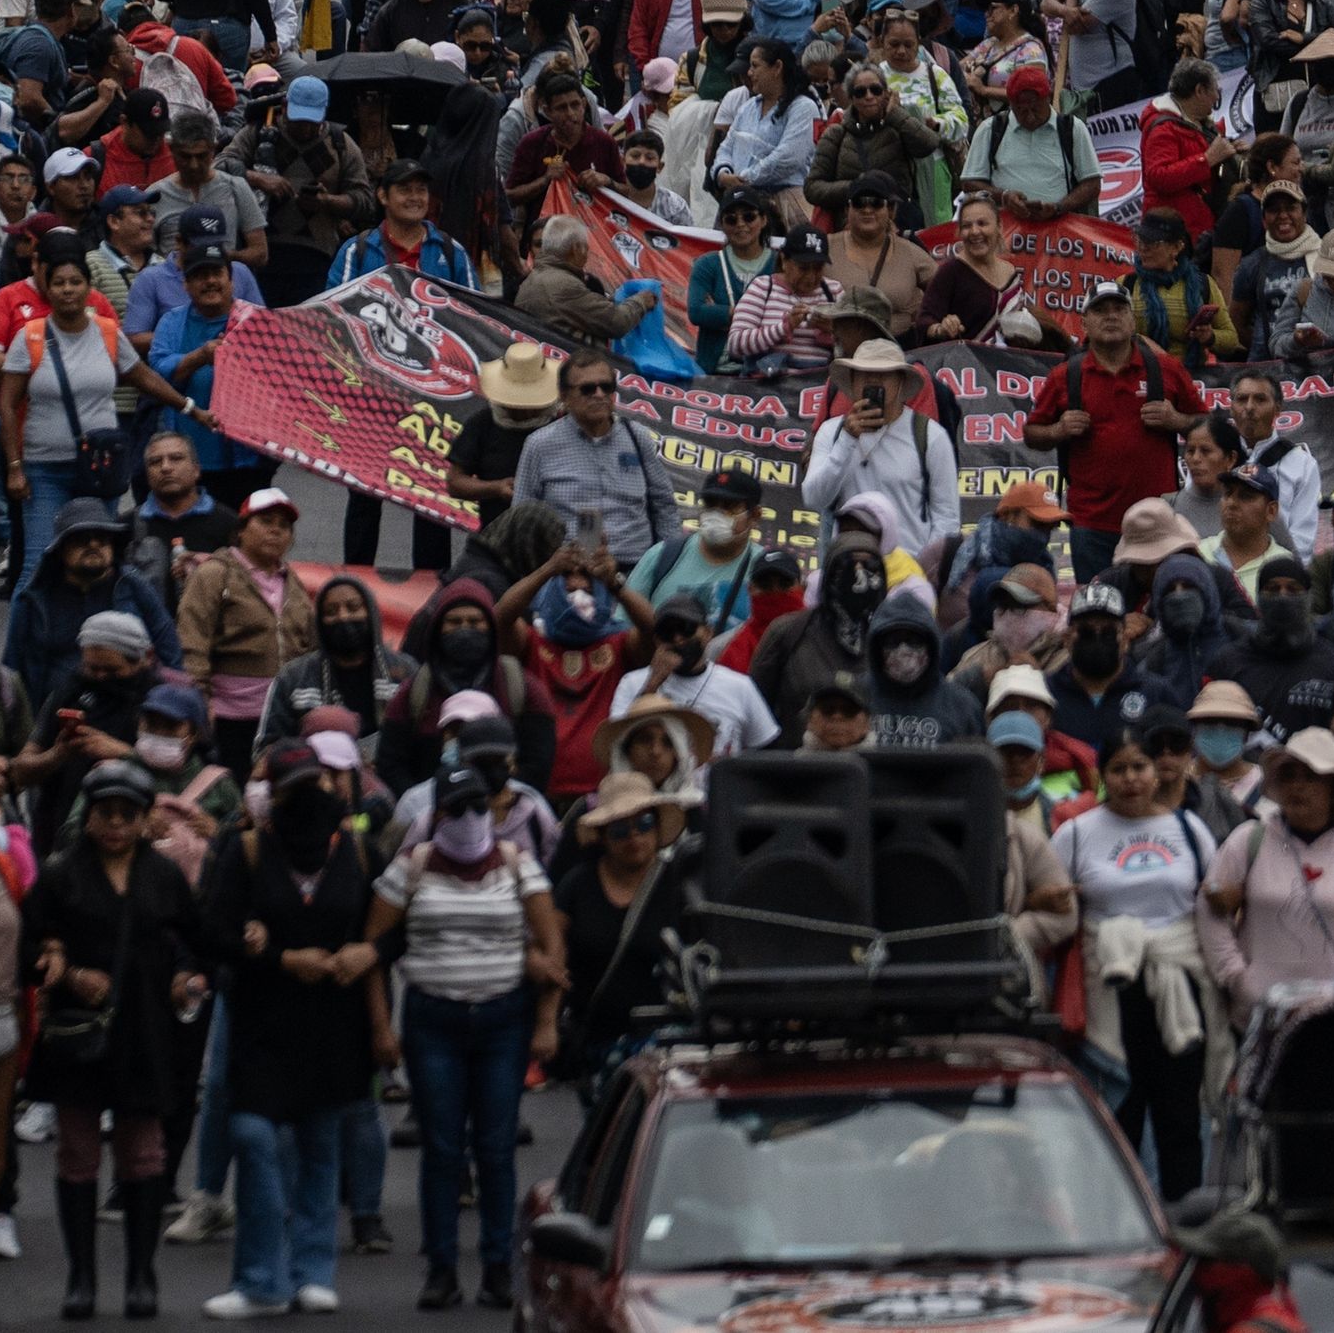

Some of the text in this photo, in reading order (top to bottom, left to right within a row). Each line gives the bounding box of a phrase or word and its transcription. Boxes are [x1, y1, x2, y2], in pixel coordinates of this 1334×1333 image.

[1012, 233, 1037, 252] DE
[1045, 237, 1083, 258] LOS
[1033, 268, 1071, 287] LOS
